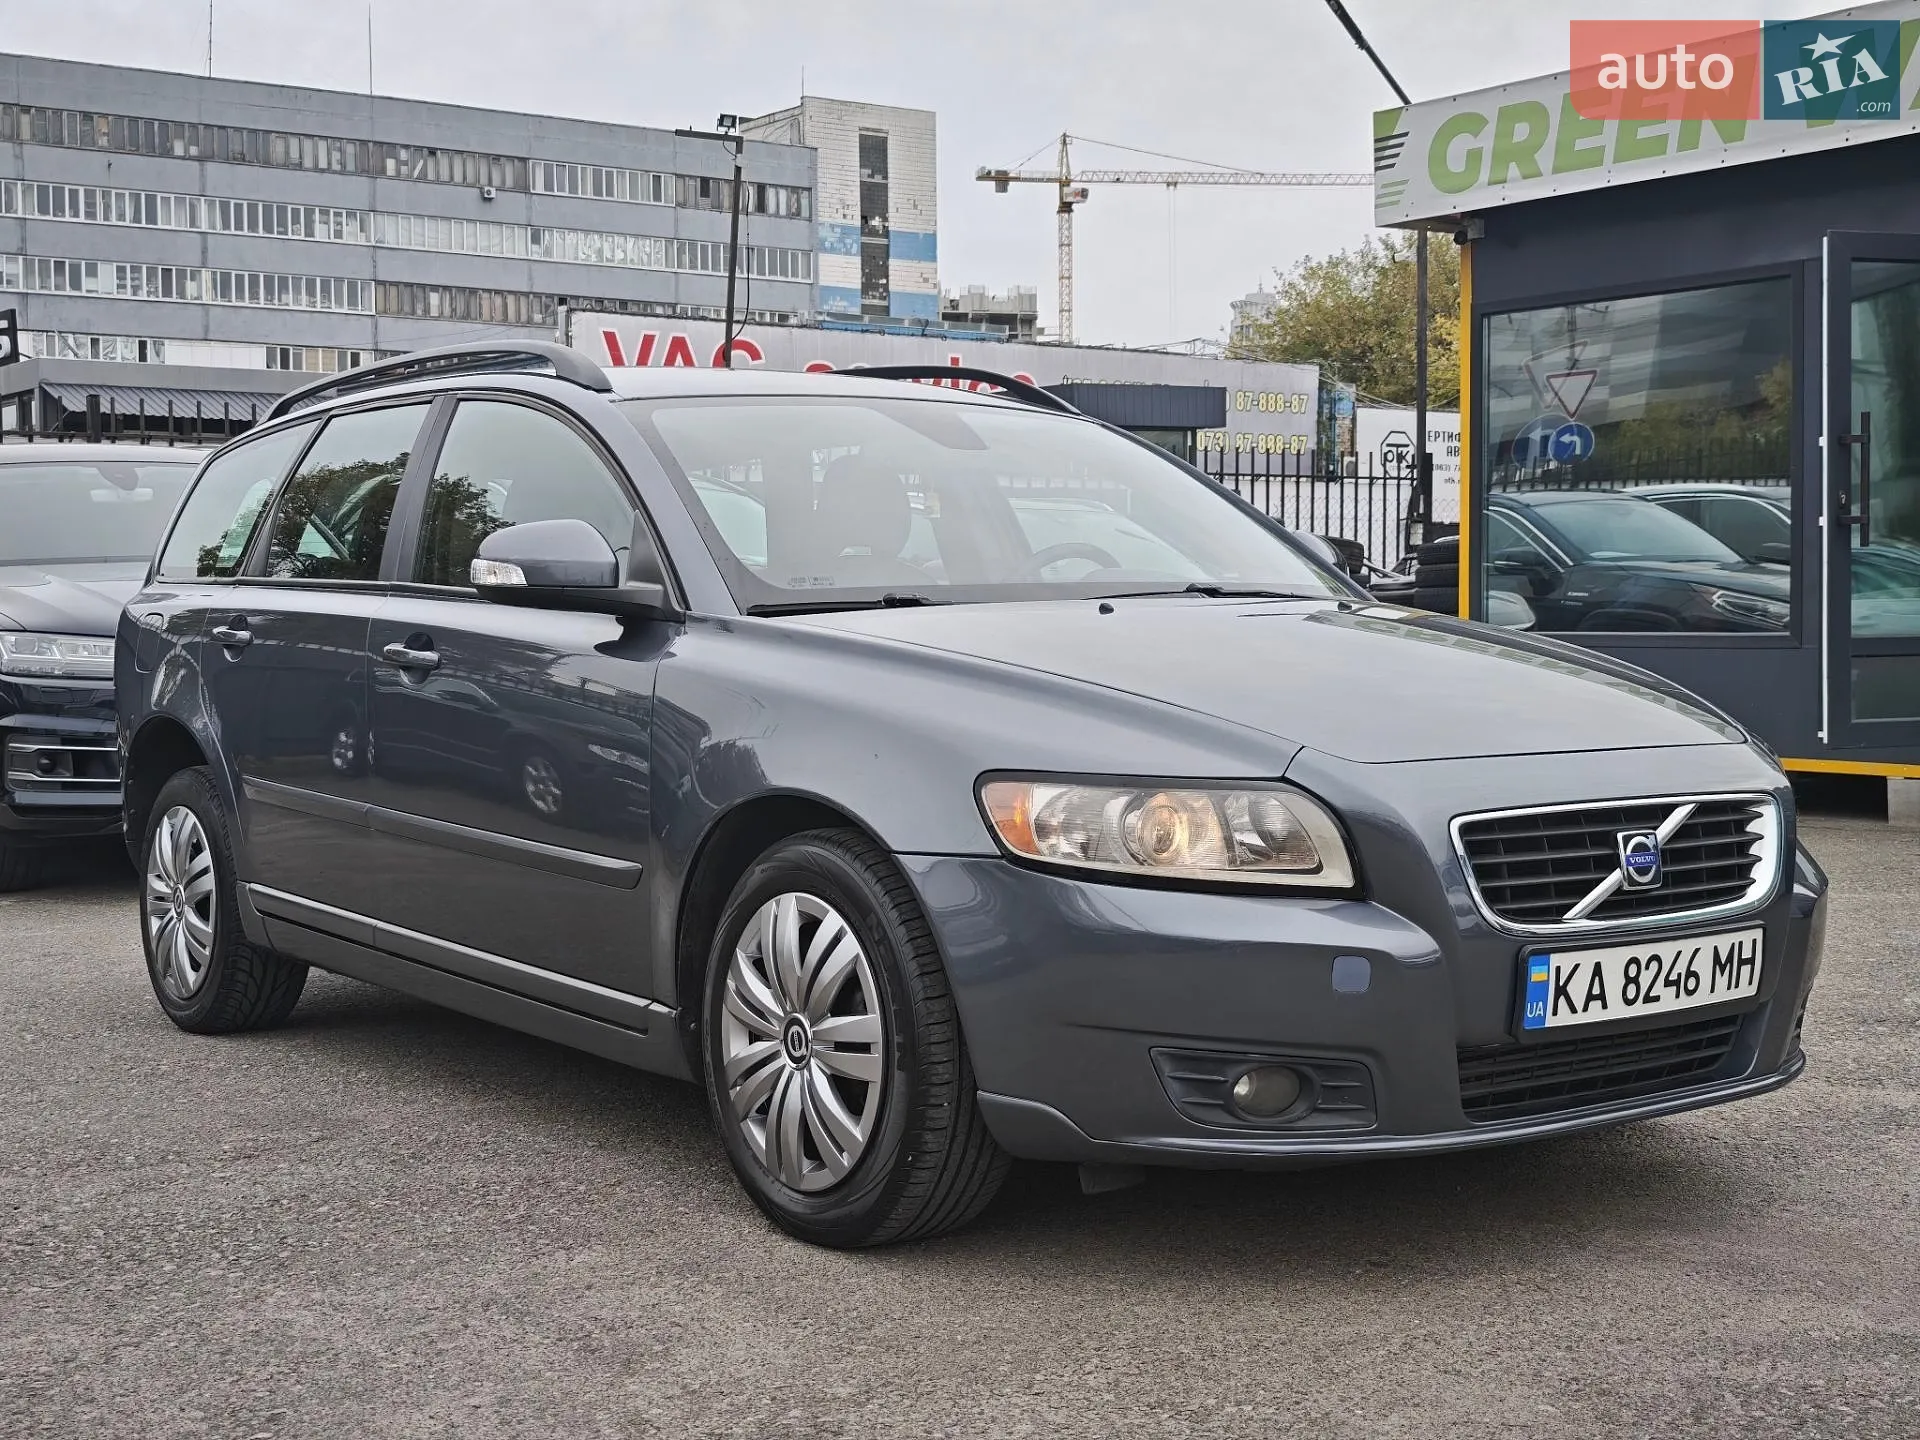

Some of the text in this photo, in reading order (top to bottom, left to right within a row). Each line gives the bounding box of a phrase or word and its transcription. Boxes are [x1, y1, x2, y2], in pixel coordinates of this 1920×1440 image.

[1427, 52, 1758, 195] GREEN
[1235, 390, 1309, 414] 87-888-87
[1235, 432, 1308, 455] 87-888-87
[1629, 855, 1656, 864] VOLVO
[1551, 937, 1758, 1017] KA 8246 MH
[1526, 1002, 1545, 1018] UA
